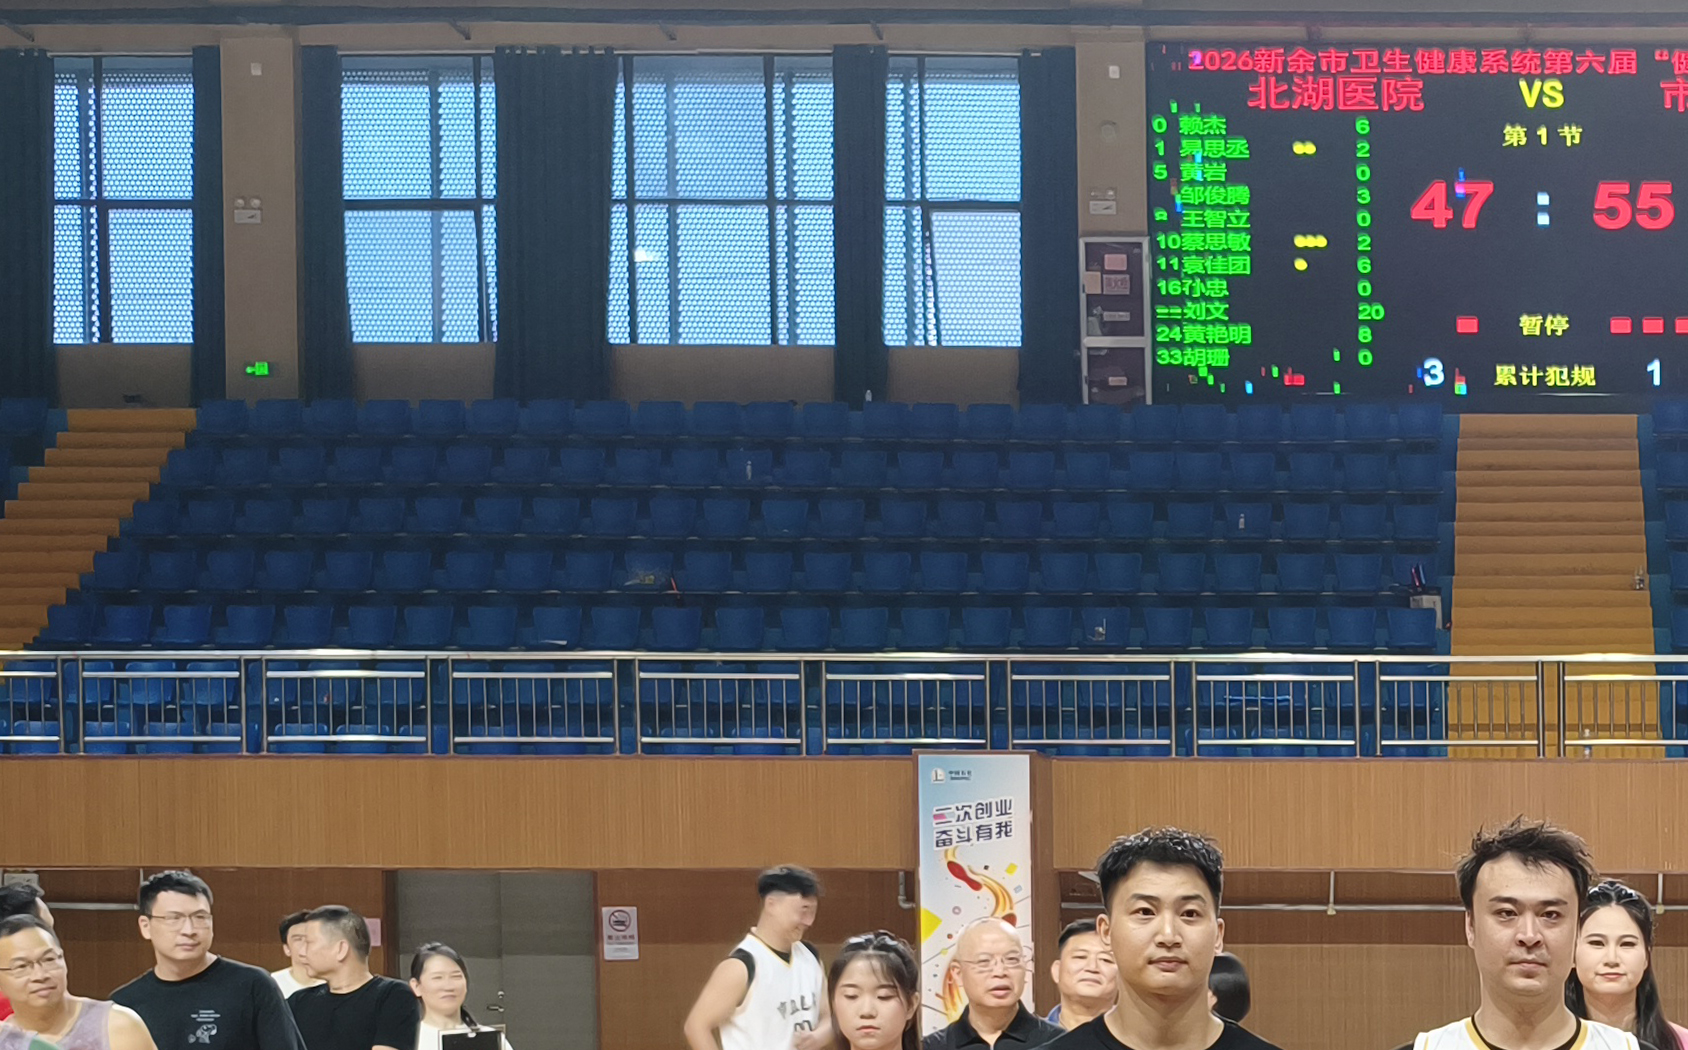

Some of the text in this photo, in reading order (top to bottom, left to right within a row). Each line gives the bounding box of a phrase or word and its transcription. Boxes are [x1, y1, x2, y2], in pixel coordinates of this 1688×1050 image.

[1247, 75, 1425, 111] 北湖医院
[1519, 79, 1564, 108] VS
[1152, 115, 1167, 133] 0
[1356, 116, 1369, 134] 6
[1155, 139, 1165, 156] 1
[1356, 140, 1370, 157] 2
[1154, 162, 1168, 179] 5
[1356, 163, 1370, 181] 0
[1356, 187, 1370, 204] 3
[1411, 179, 1494, 229] 47
[1593, 181, 1675, 230] 55
[1181, 209, 1250, 228] 王智立
[1356, 210, 1370, 227] 0
[1157, 233, 1181, 249] 10
[1357, 234, 1371, 250] 2
[1157, 256, 1179, 270] 11
[1357, 256, 1371, 274] 6
[1157, 276, 1372, 297] 16 孙忠 0
[1183, 300, 1229, 320] 刘文
[1358, 303, 1384, 319] 20
[1156, 325, 1182, 342] 24
[1358, 326, 1373, 343] 8
[1518, 313, 1570, 336] 暂停
[1156, 347, 1182, 365] 33
[1358, 349, 1373, 366] 0
[1423, 357, 1445, 387] 3
[1493, 363, 1597, 388] 累计犯规
[1646, 358, 1661, 386] 1
[934, 798, 1013, 826] 二次创业
[935, 820, 1013, 848] 奋斗有我
